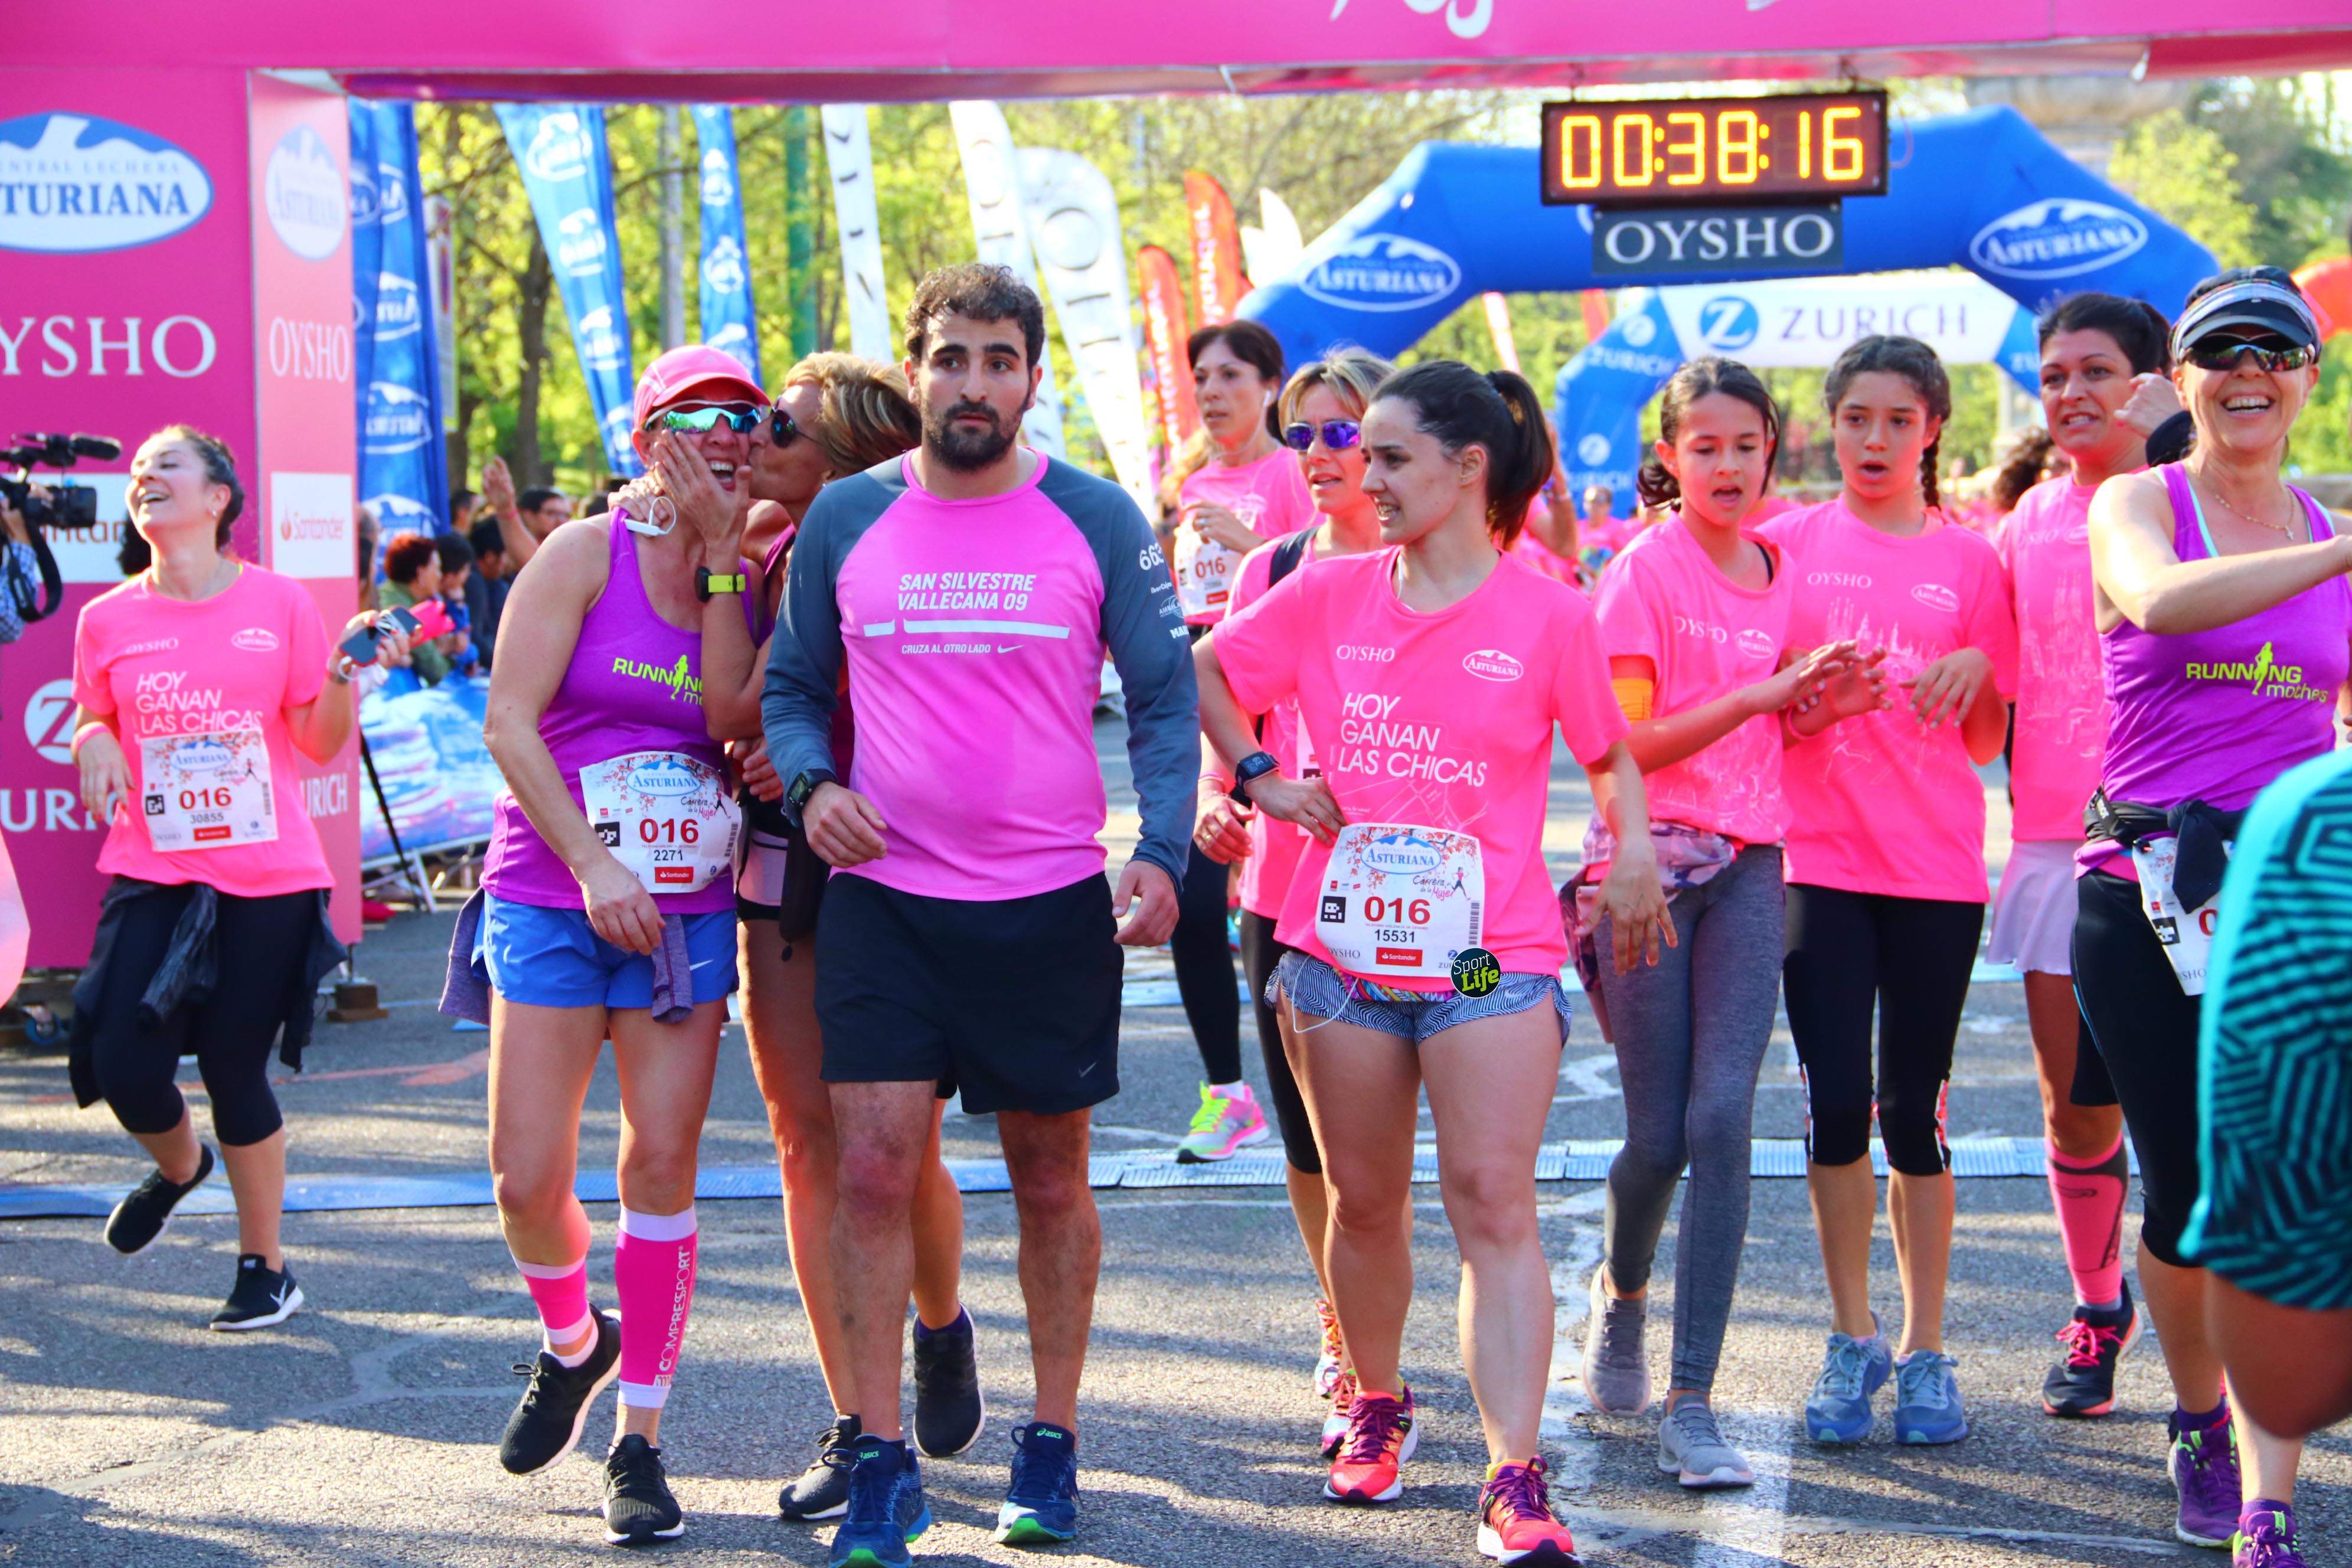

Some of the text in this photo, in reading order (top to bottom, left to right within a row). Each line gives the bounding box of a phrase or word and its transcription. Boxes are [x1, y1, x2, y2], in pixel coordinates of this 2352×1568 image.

[1562, 106, 1864, 188] 00:38:16
[1605, 214, 1834, 264] OYSHO
[1779, 303, 1966, 342] ZURICH
[269, 316, 350, 382] OYSHO
[1195, 557, 1226, 579] 016
[899, 572, 1037, 592] SAN SILVESTRE
[1807, 573, 1872, 589] OYSHO
[898, 592, 1028, 611] VALLECANA 09
[901, 644, 992, 655] CRUZA AL OTRO LADO
[1336, 645, 1395, 662] OYSHO
[1468, 656, 1518, 677] ASTURIANA
[136, 671, 187, 693] HOY
[136, 689, 222, 713] GANAN
[1342, 692, 1401, 720] HOY
[141, 710, 263, 734] LAS CHICAS
[1341, 719, 1440, 752] GANAN
[1338, 746, 1380, 776] LAS
[1386, 752, 1488, 788] CHICAS
[633, 775, 698, 788] ASTURIANA
[179, 787, 232, 810] 016
[681, 796, 708, 807] Carrera
[190, 812, 224, 824] 30855
[639, 818, 699, 844] 016
[654, 850, 683, 861] 2271
[1366, 848, 1435, 866] ASTURIANA
[1413, 875, 1445, 886] Carrera
[1364, 896, 1431, 925] 016
[1374, 929, 1415, 943] 15531
[1453, 953, 1491, 975] Sport
[1461, 966, 1500, 992] Life
